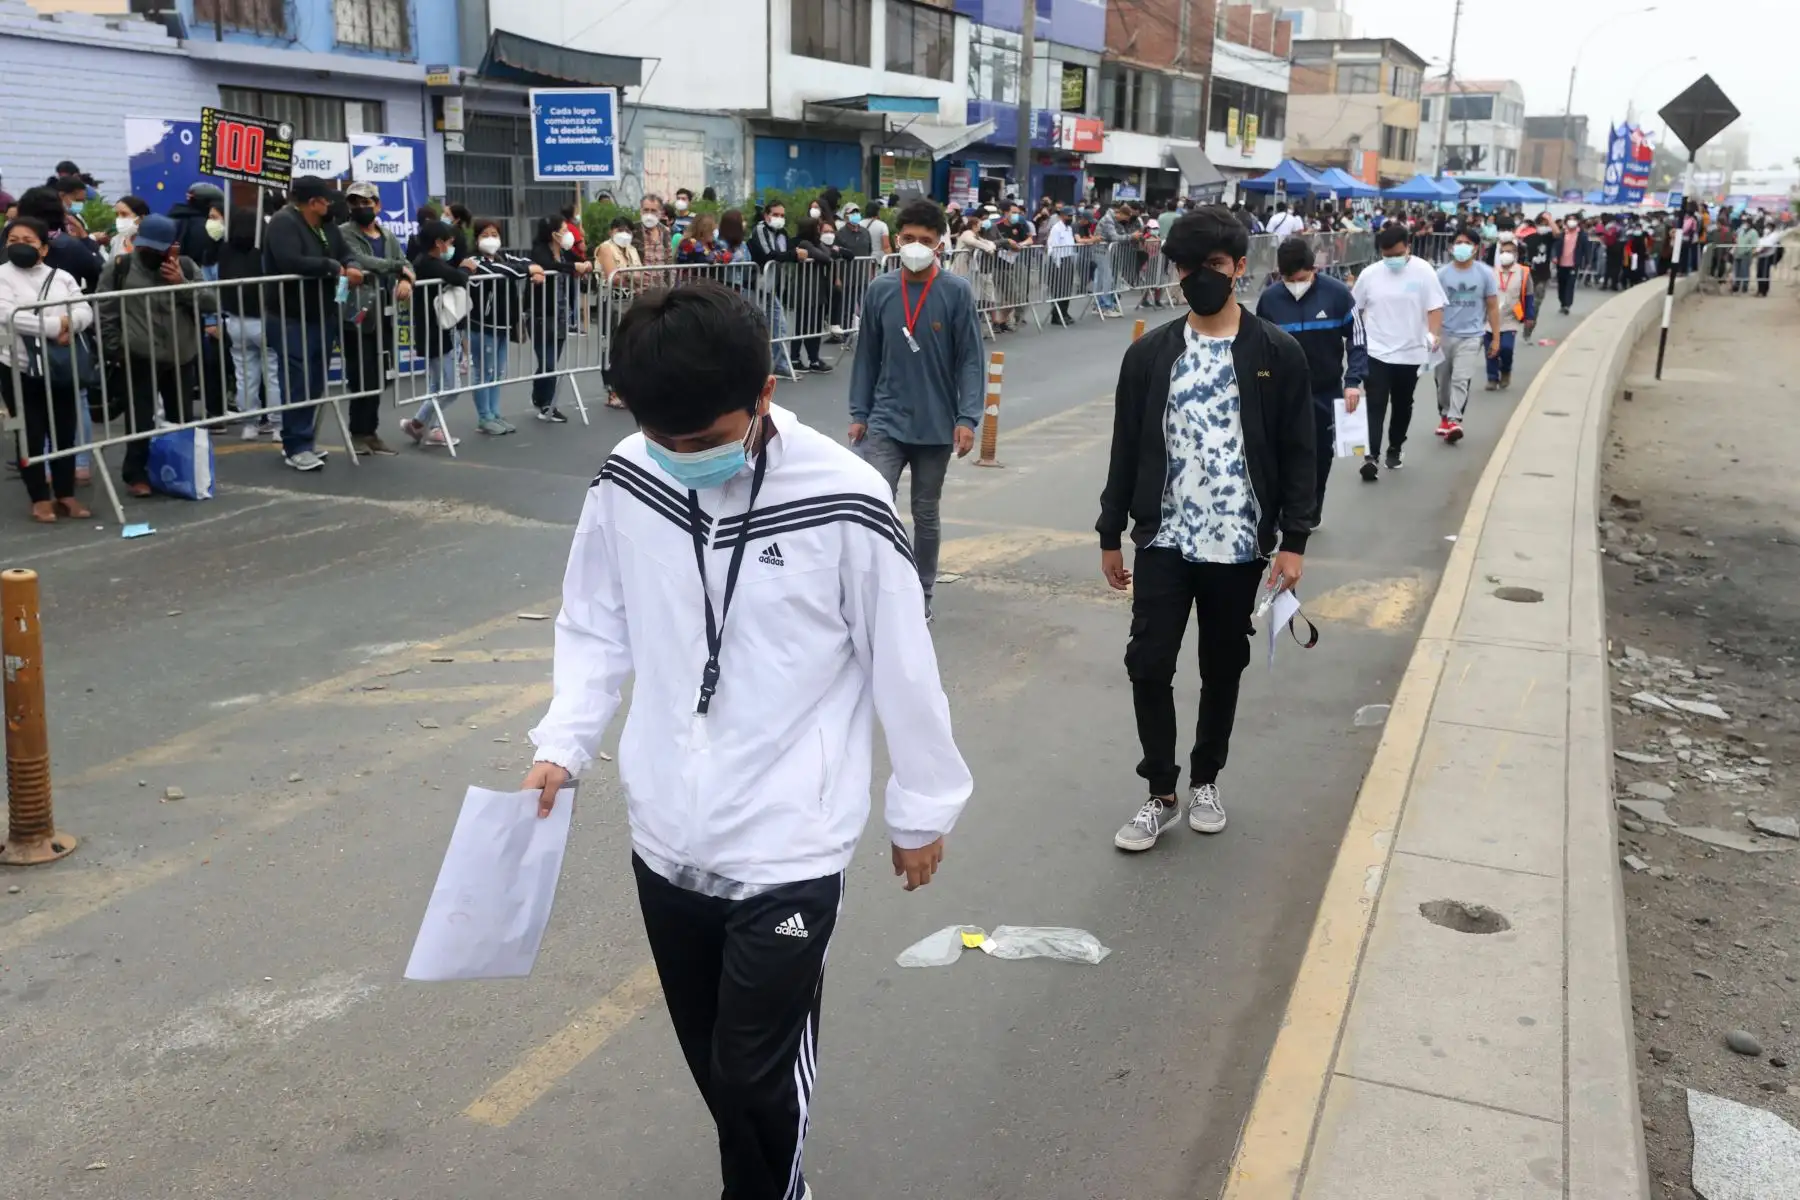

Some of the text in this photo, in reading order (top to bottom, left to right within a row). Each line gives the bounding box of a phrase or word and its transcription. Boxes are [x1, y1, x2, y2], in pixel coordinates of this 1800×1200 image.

[550, 107, 596, 116] Cada logro
[544, 117, 585, 125] comienza
[560, 126, 597, 134] decisión
[545, 136, 557, 144] de
[215, 119, 264, 175] 100
[292, 154, 332, 171] Pamer
[366, 159, 400, 174] Pamer
[758, 555, 785, 567] adidas
[774, 924, 809, 939] adidas
